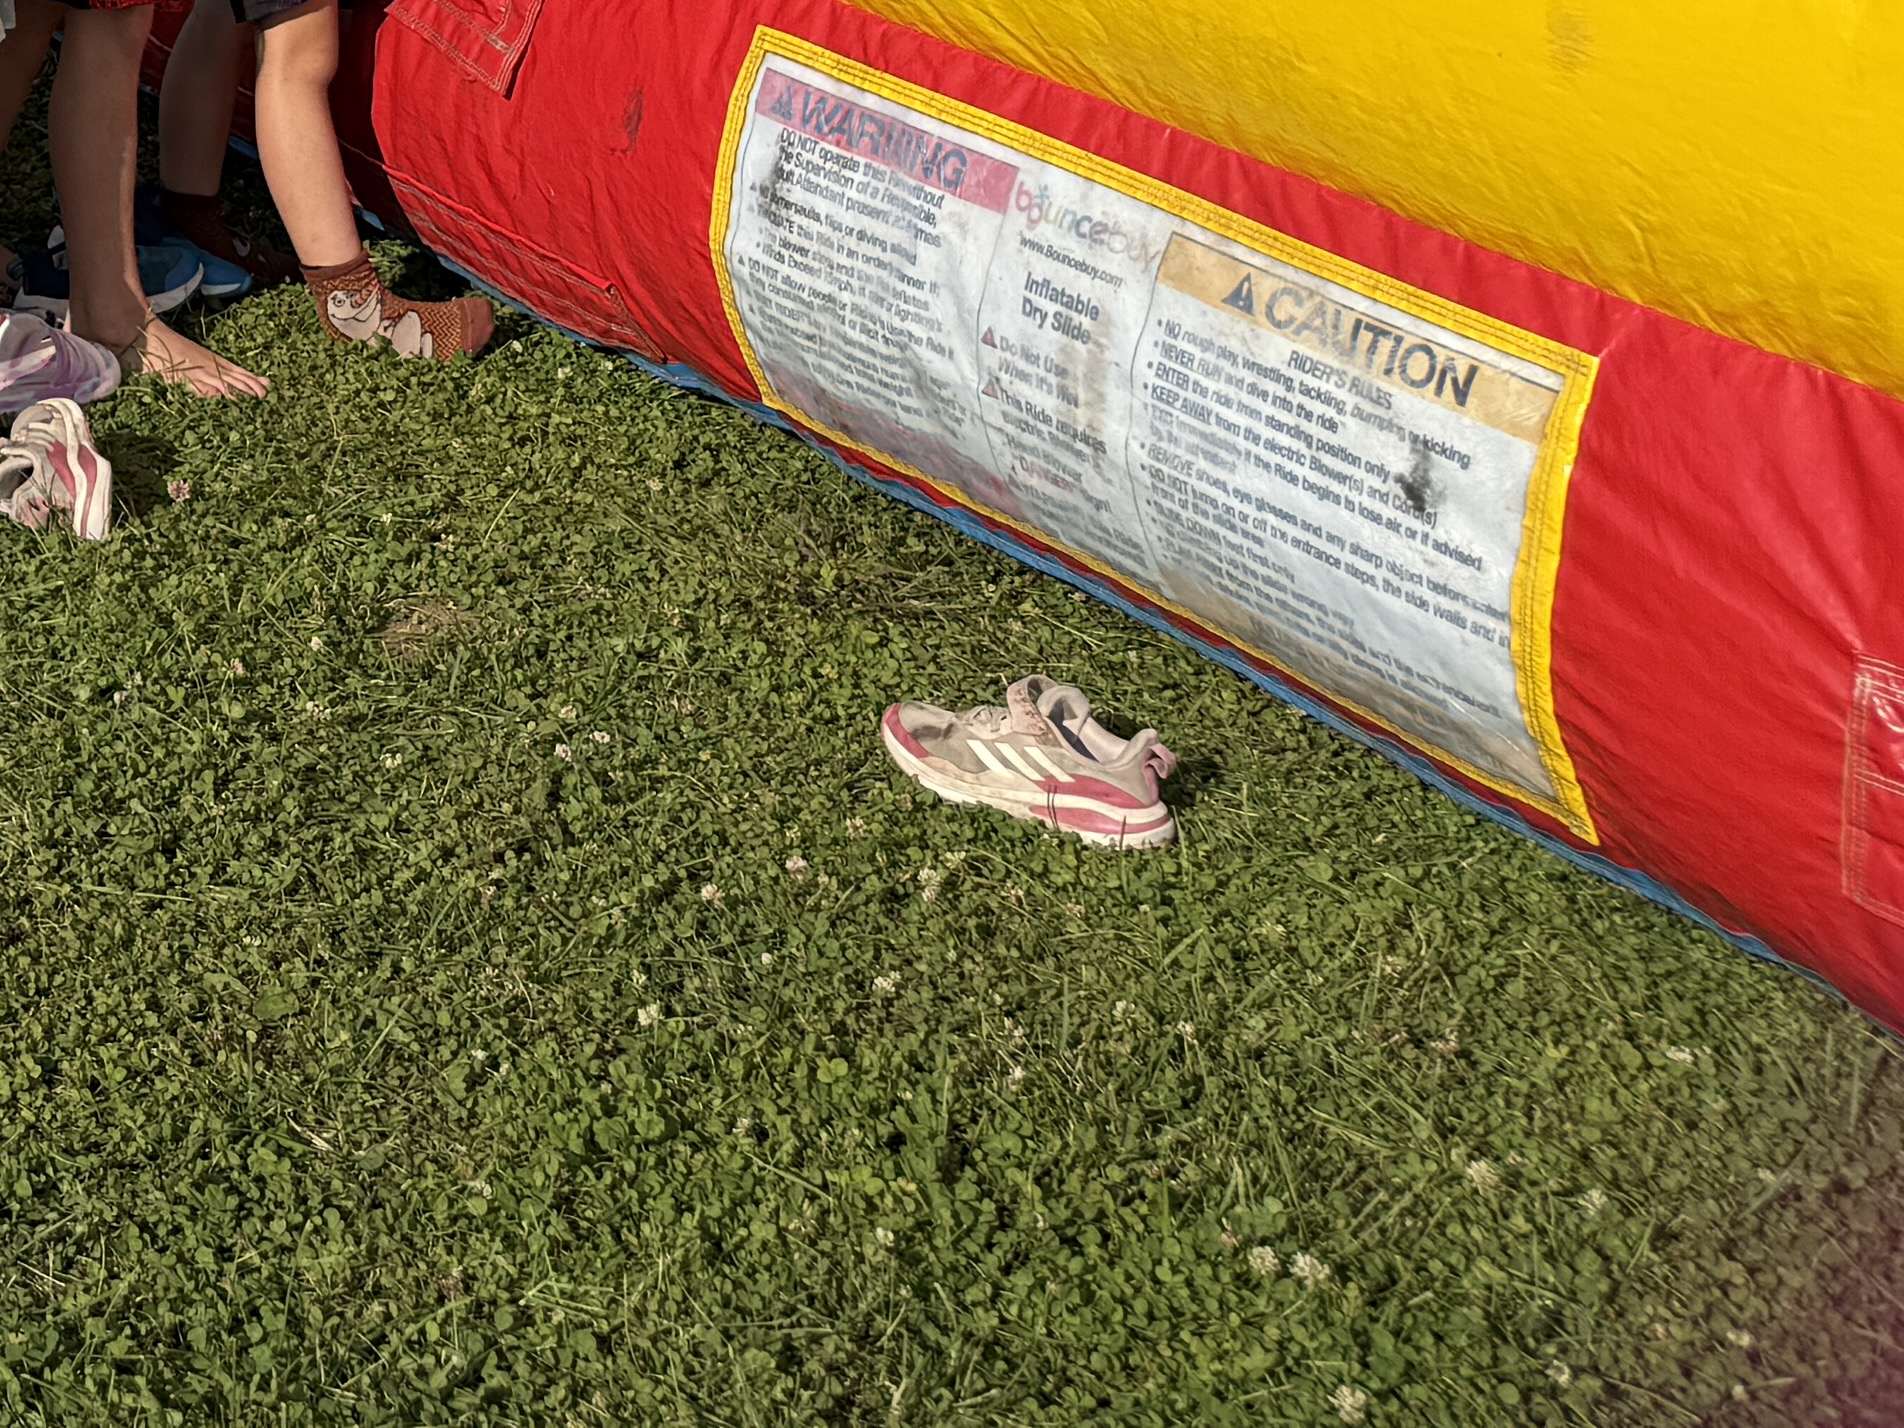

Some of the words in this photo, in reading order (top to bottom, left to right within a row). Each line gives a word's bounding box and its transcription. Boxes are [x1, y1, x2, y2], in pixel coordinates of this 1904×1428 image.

[780, 126, 796, 147] DO
[796, 133, 819, 156] NOT
[817, 143, 860, 179] operate
[793, 150, 855, 194] Supervision
[1021, 296, 1048, 329] Dry
[1051, 310, 1091, 345] Slide
[1024, 272, 1099, 321] Inflatable
[1000, 335, 1017, 354] Do
[1262, 280, 1478, 412] CAUTION
[1287, 348, 1347, 391] RIDER'S
[1025, 395, 1053, 425] Ride
[1160, 340, 1194, 369] NEVER
[1245, 379, 1270, 403] dive
[1270, 391, 1294, 414] into
[1295, 402, 1314, 422] the
[1315, 412, 1338, 434] ride
[1215, 343, 1240, 367] play,
[1240, 354, 1296, 393] wrestling,
[1297, 379, 1349, 416] tackling,
[1420, 431, 1471, 471] kicking
[1150, 382, 1180, 409] KEEP
[1180, 396, 1212, 424] AWAY
[1213, 411, 1241, 437] from
[1243, 424, 1262, 446] the
[1262, 433, 1306, 468] electric
[1308, 454, 1365, 496] Blower(s)
[1366, 481, 1391, 506] and
[1155, 361, 1190, 390] ENTER
[1263, 411, 1314, 450] standing
[1314, 434, 1363, 472] position
[1363, 457, 1390, 485] only
[1252, 450, 1273, 473] the
[1273, 459, 1300, 487] Ride
[1301, 473, 1342, 509] begins
[1343, 493, 1357, 513] to
[1357, 500, 1383, 526] lose
[1404, 523, 1418, 541] or
[1431, 533, 1482, 572] advised
[1301, 516, 1321, 539] and
[1326, 530, 1346, 553] any
[1349, 538, 1382, 571] sharp
[1291, 533, 1341, 571] entrance
[1344, 560, 1379, 591] steps,
[1383, 577, 1401, 599] the
[1405, 588, 1429, 613] side
[1433, 600, 1467, 631] walls
